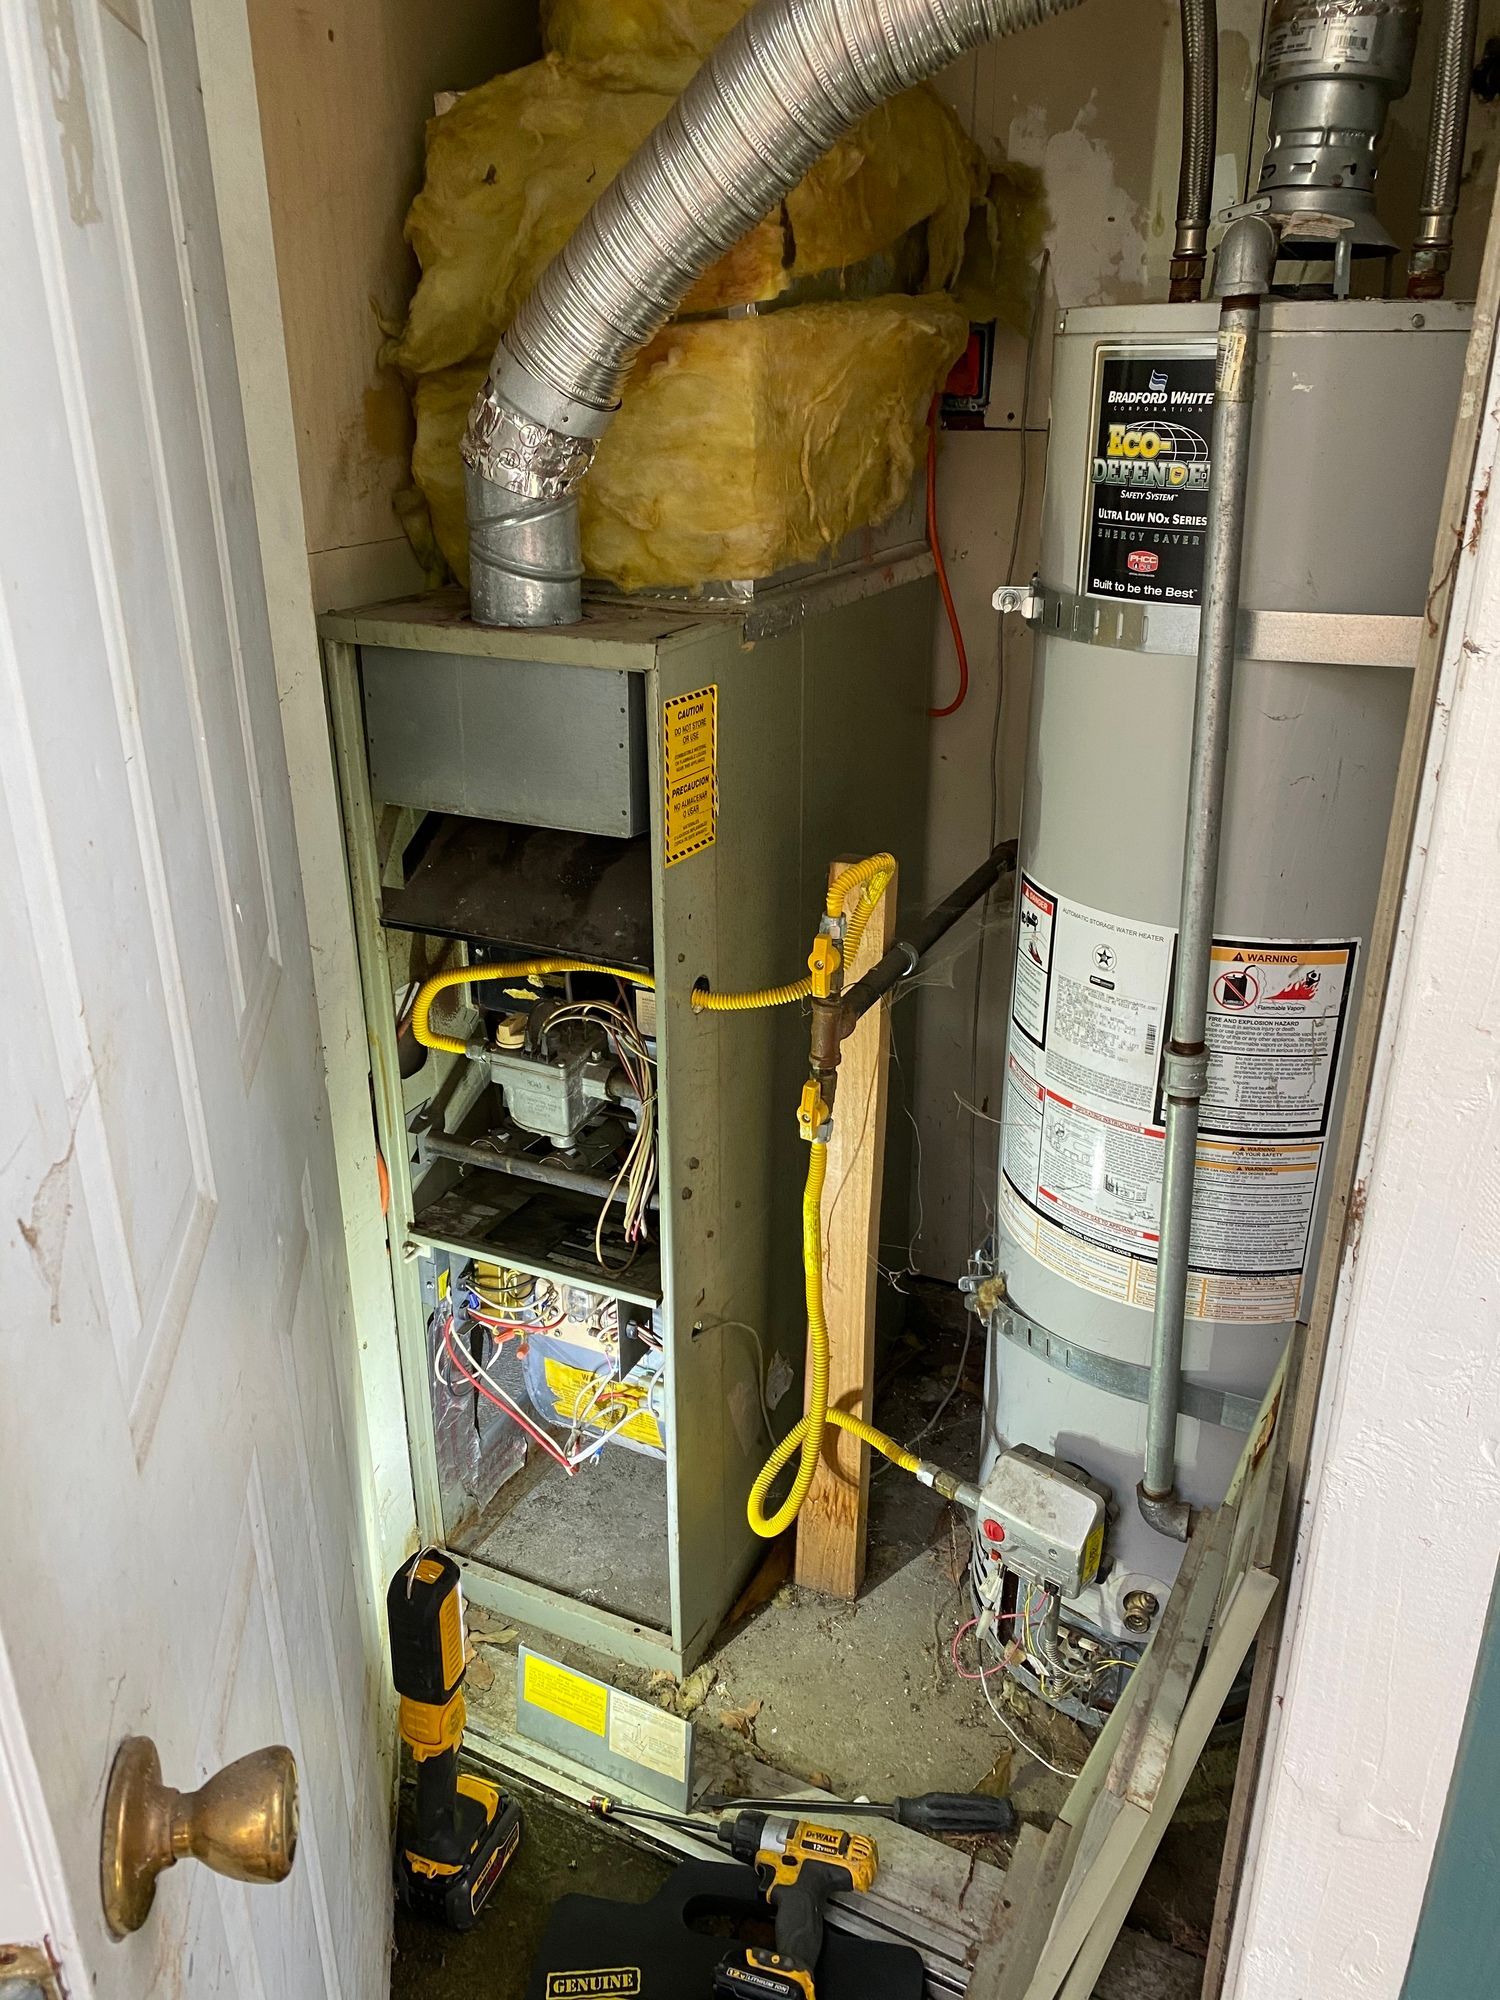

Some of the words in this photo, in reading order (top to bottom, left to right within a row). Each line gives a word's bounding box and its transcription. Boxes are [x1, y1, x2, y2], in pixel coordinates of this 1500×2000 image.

[1108, 390, 1168, 404] BRADFORD
[1170, 391, 1215, 405] WHITE
[1120, 490, 1145, 500] SAFETY
[1098, 508, 1122, 520] ULTRA
[1125, 511, 1145, 521] LOW
[1172, 514, 1208, 526] SERIES
[1098, 528, 1144, 541] ENERGY
[1153, 534, 1200, 546] SAVER
[1130, 554, 1157, 564] PHCC
[1093, 578, 1112, 590] Built
[1114, 581, 1126, 592] to
[1127, 582, 1141, 594] be
[1144, 585, 1162, 596] the
[1166, 587, 1194, 598] Best
[678, 702, 704, 720] CAUTION
[674, 727, 682, 736] DO
[682, 723, 692, 734] NOT
[692, 718, 707, 730] STORE
[682, 734, 690, 744] OR
[690, 731, 700, 742] USE
[672, 774, 710, 799] PRECAUCION
[674, 802, 681, 813] NO
[682, 790, 708, 808] ALMACENAR
[688, 804, 700, 816] USAR
[1062, 908, 1088, 922] AUTOMATIC
[1090, 918, 1115, 931] STORAGE
[1116, 926, 1138, 937] WATER
[1138, 932, 1164, 942] HEATER
[1247, 953, 1298, 964] WARNING
[1286, 1004, 1306, 1012] Vapors
[1102, 1116, 1140, 1132] INSTRUCTIONS
[1062, 1226, 1083, 1239] CONTROL
[1084, 1236, 1113, 1252] DIAGNOSTIC
[1114, 1248, 1132, 1257] CODES
[552, 1974, 634, 1994] GENUINE
[748, 1976, 774, 1987] LITHIUM
[774, 1984, 787, 1992] ION
